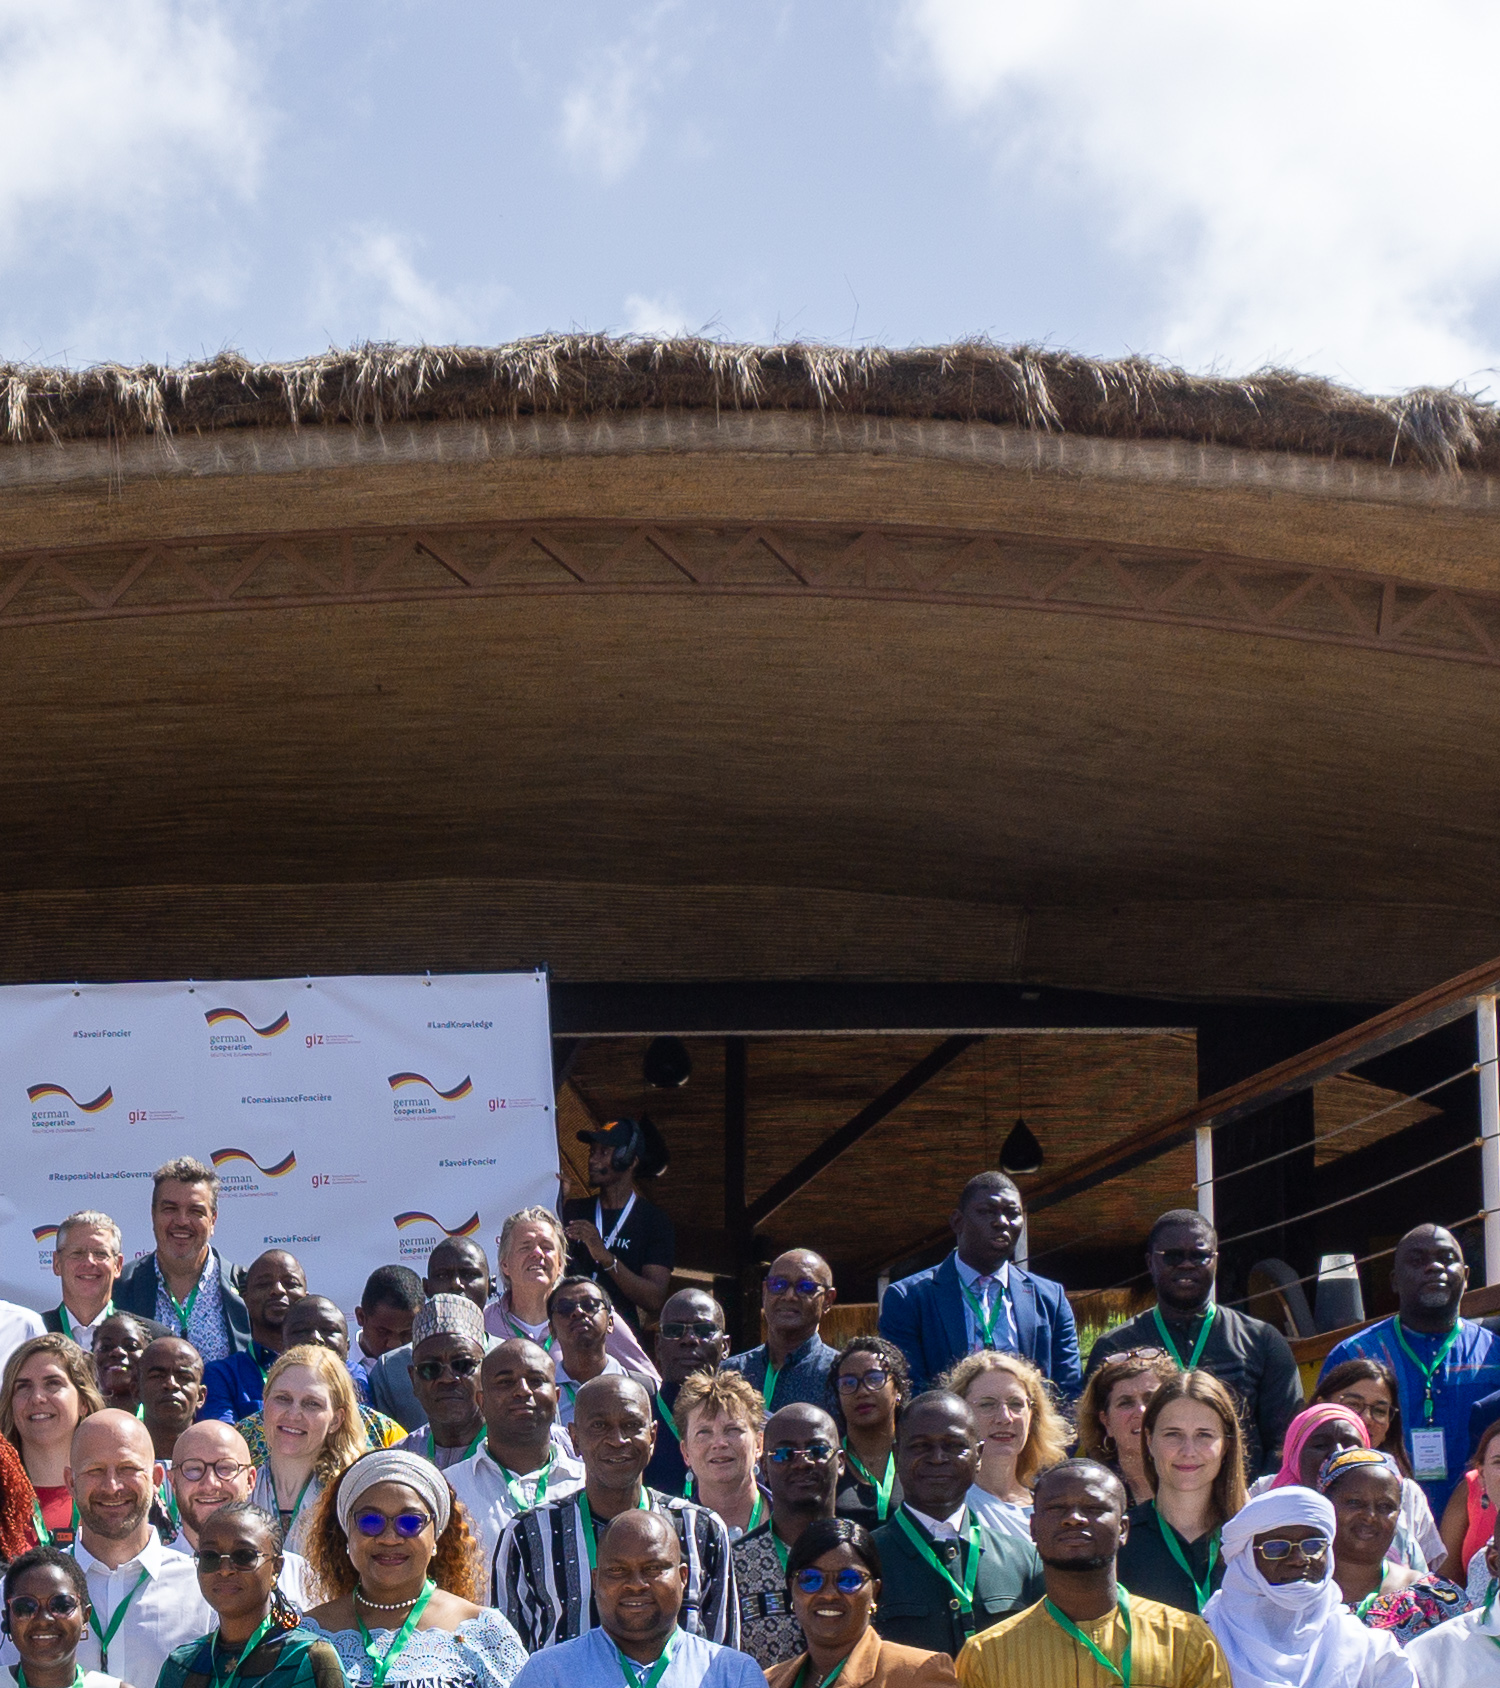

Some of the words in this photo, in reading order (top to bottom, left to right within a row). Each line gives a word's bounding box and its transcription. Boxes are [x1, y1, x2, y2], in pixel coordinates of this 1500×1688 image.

[427, 1020, 493, 1030] #LandKnowledge
[73, 1029, 132, 1038] #SavoirFoncier
[210, 1034, 246, 1045] german
[305, 1033, 324, 1048] giz
[210, 1044, 253, 1052] cooperation
[241, 1093, 332, 1104] #ConnaissanceFoncière
[393, 1098, 430, 1109] german
[488, 1097, 507, 1112] giz
[31, 1110, 69, 1121] german
[129, 1109, 147, 1124] giz
[394, 1107, 437, 1115] cooperation
[32, 1119, 76, 1128] cooperation
[439, 1158, 497, 1167] #SavoirFoncier
[312, 1173, 330, 1188] giz
[263, 1234, 321, 1244] #SavoirFoncier
[399, 1236, 437, 1247] german
